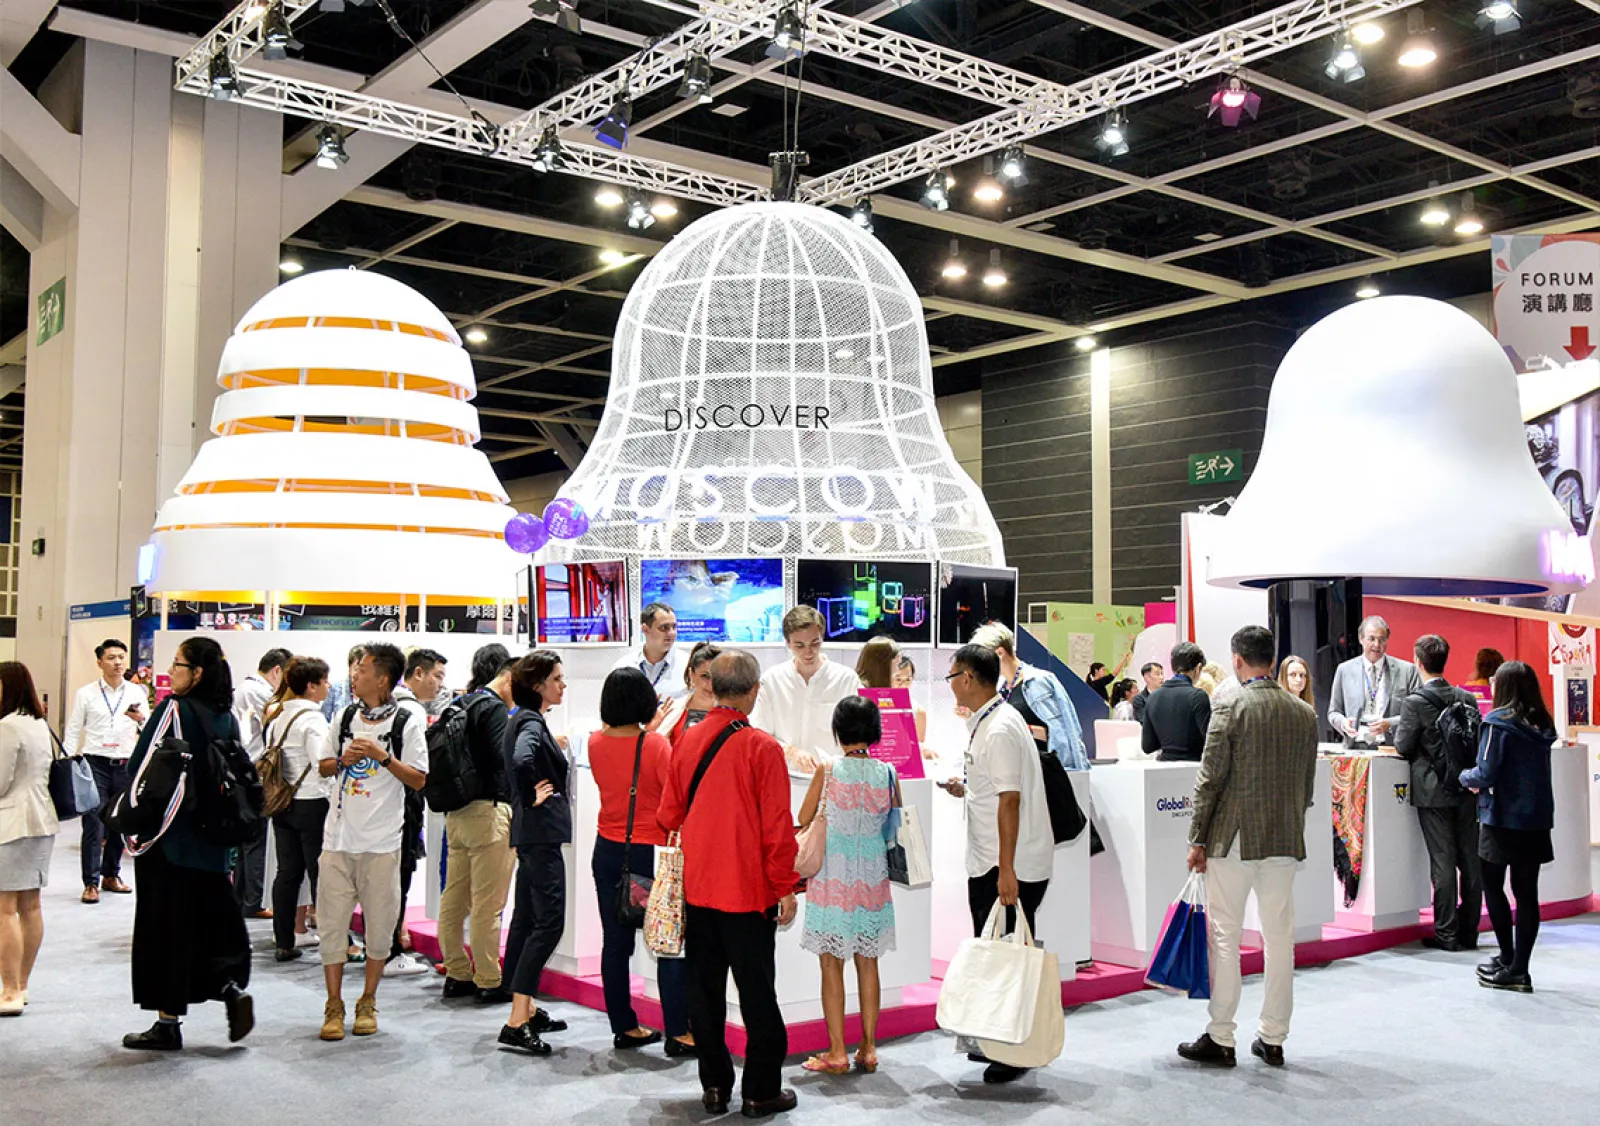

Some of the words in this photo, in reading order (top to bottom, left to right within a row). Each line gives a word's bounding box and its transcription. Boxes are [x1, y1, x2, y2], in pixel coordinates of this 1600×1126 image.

[1521, 272, 1594, 287] FORUM
[1522, 293, 1594, 313] 演講廳
[665, 404, 830, 431] DISCOVER
